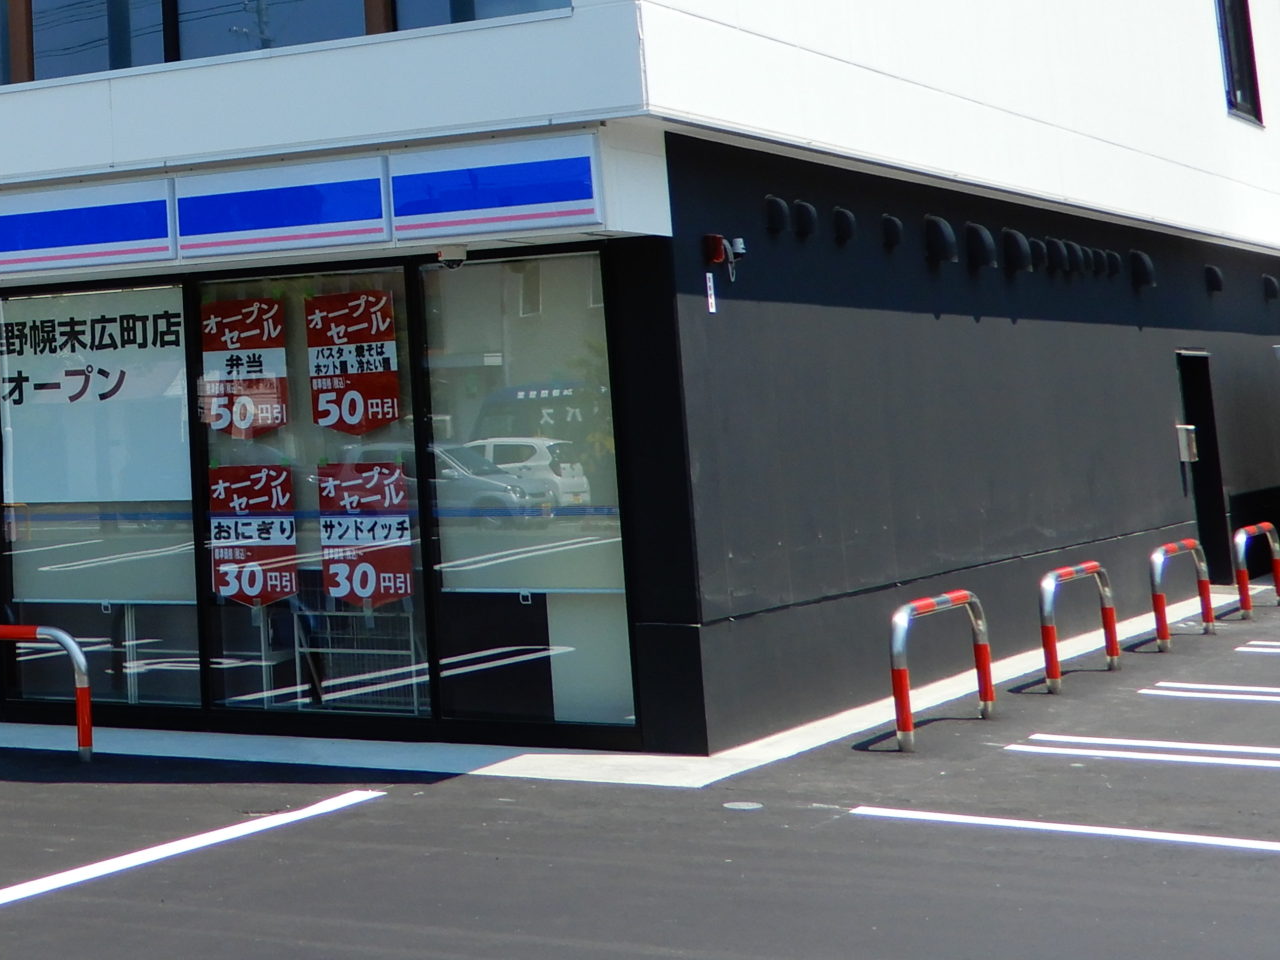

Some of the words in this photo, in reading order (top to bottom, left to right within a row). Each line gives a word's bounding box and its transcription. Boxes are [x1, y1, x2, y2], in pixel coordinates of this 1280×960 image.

[202, 302, 279, 334] オープン
[307, 294, 387, 329] オープン
[220, 318, 282, 349] セール
[327, 311, 391, 344] セール
[225, 353, 264, 375] 弁当
[210, 468, 288, 499] オープン
[320, 466, 401, 497] オープン
[229, 486, 291, 515] セール
[340, 484, 405, 514] セール
[213, 520, 295, 541] おにぎり
[322, 519, 409, 540] サンドイッチ
